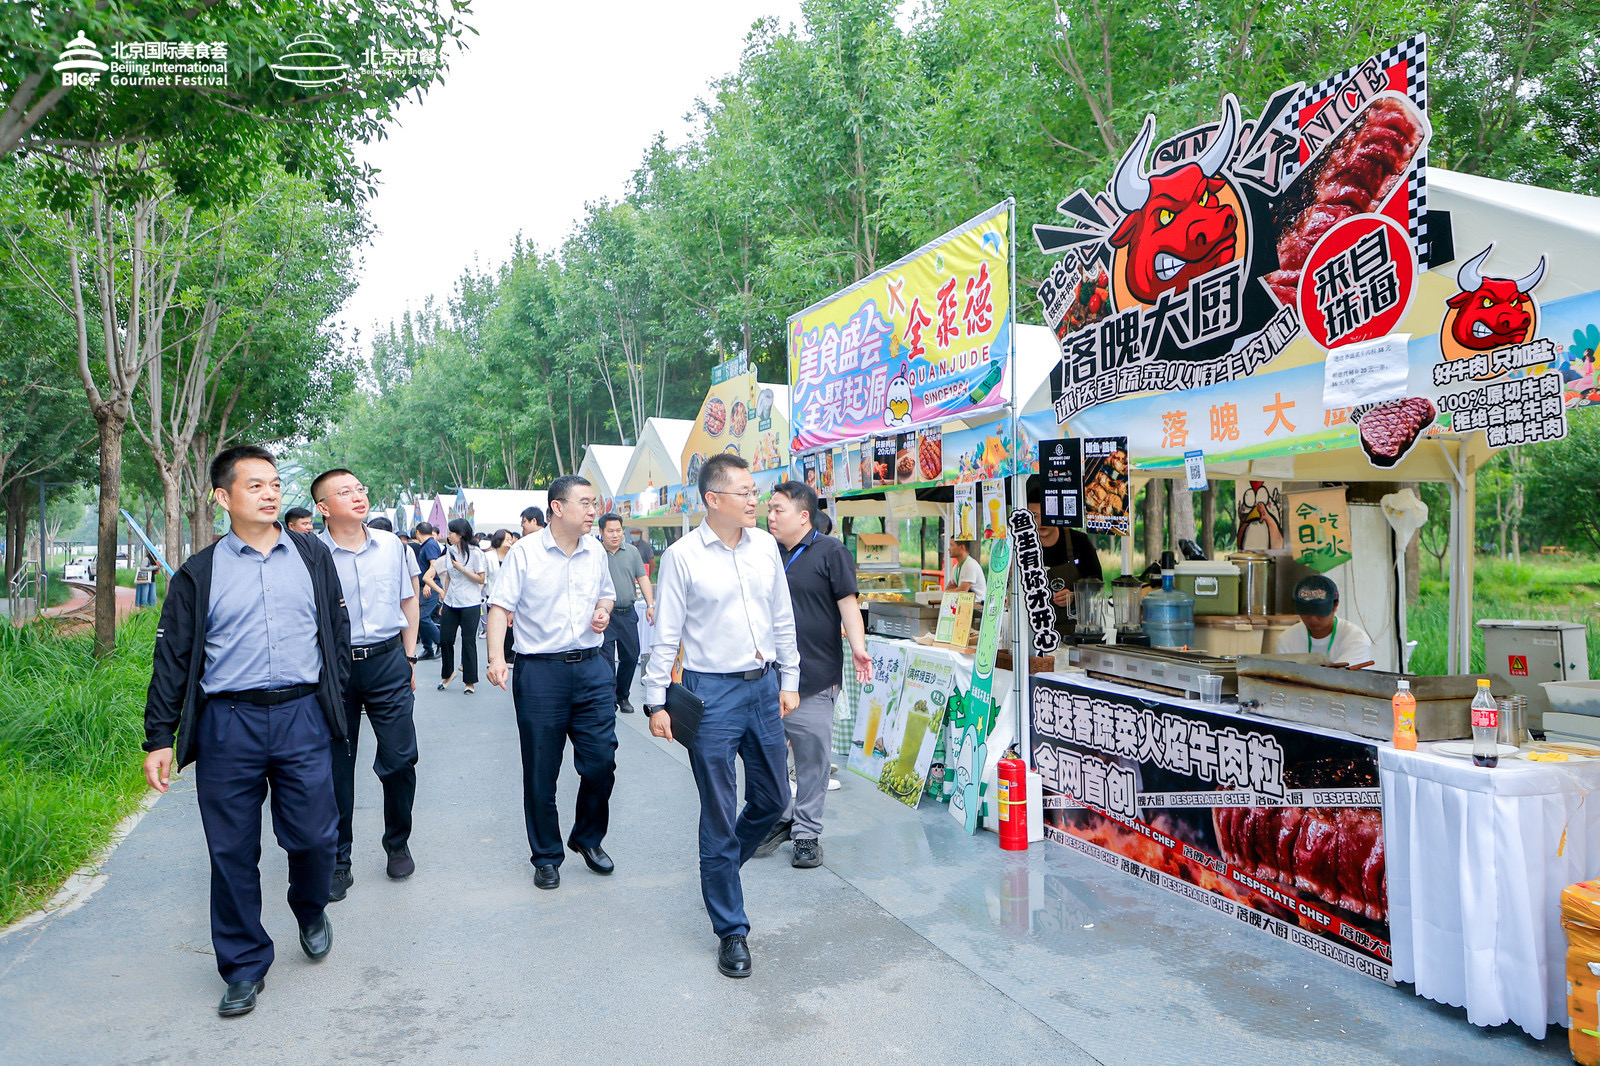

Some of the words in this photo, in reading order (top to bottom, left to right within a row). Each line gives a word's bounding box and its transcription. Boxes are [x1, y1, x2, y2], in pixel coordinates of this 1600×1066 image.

[1301, 57, 1387, 155] NICE
[1038, 246, 1081, 311] Bee
[1316, 226, 1391, 305] 来自
[1323, 263, 1399, 343] 珠海
[903, 263, 992, 361] 全聚德
[1062, 264, 1241, 390] 落魄大厨
[795, 303, 893, 403] 美食盛会
[909, 345, 990, 386] QUANJUDE
[1434, 355, 1489, 386] 好牛肉
[1491, 338, 1556, 373] 只加盐
[802, 363, 889, 430] 全聚起源
[1438, 374, 1560, 412] 100%原切牛肉
[1453, 396, 1562, 432] 拒绝合成牛肉
[1487, 417, 1563, 446] 微调牛肉
[1296, 503, 1317, 563] 今日宜
[1011, 512, 1058, 648] 鱼生有你才开心
[1034, 687, 1285, 798] 迷迭香蔬菜火焰牛肉粒
[1034, 742, 1137, 820] 全网首创
[1170, 794, 1223, 805] DESPERATE
[1224, 793, 1250, 805] CHEF
[1106, 807, 1151, 837] DESPERATE
[1152, 831, 1176, 849] CHEF
[1183, 845, 1228, 876] 落魄大厨
[1232, 869, 1296, 910] DESPERATE
[1299, 902, 1331, 927] CHEF
[1065, 836, 1100, 860] DESPERATE
[1100, 852, 1119, 866] CHEF
[1120, 858, 1160, 885] 落魄大厨
[1161, 876, 1209, 907] DESPERATE
[1209, 896, 1234, 915] CHEF
[1236, 905, 1288, 941] 落魄大厨
[1291, 930, 1355, 968] DESPERATE
[1356, 956, 1389, 981] CHEF
